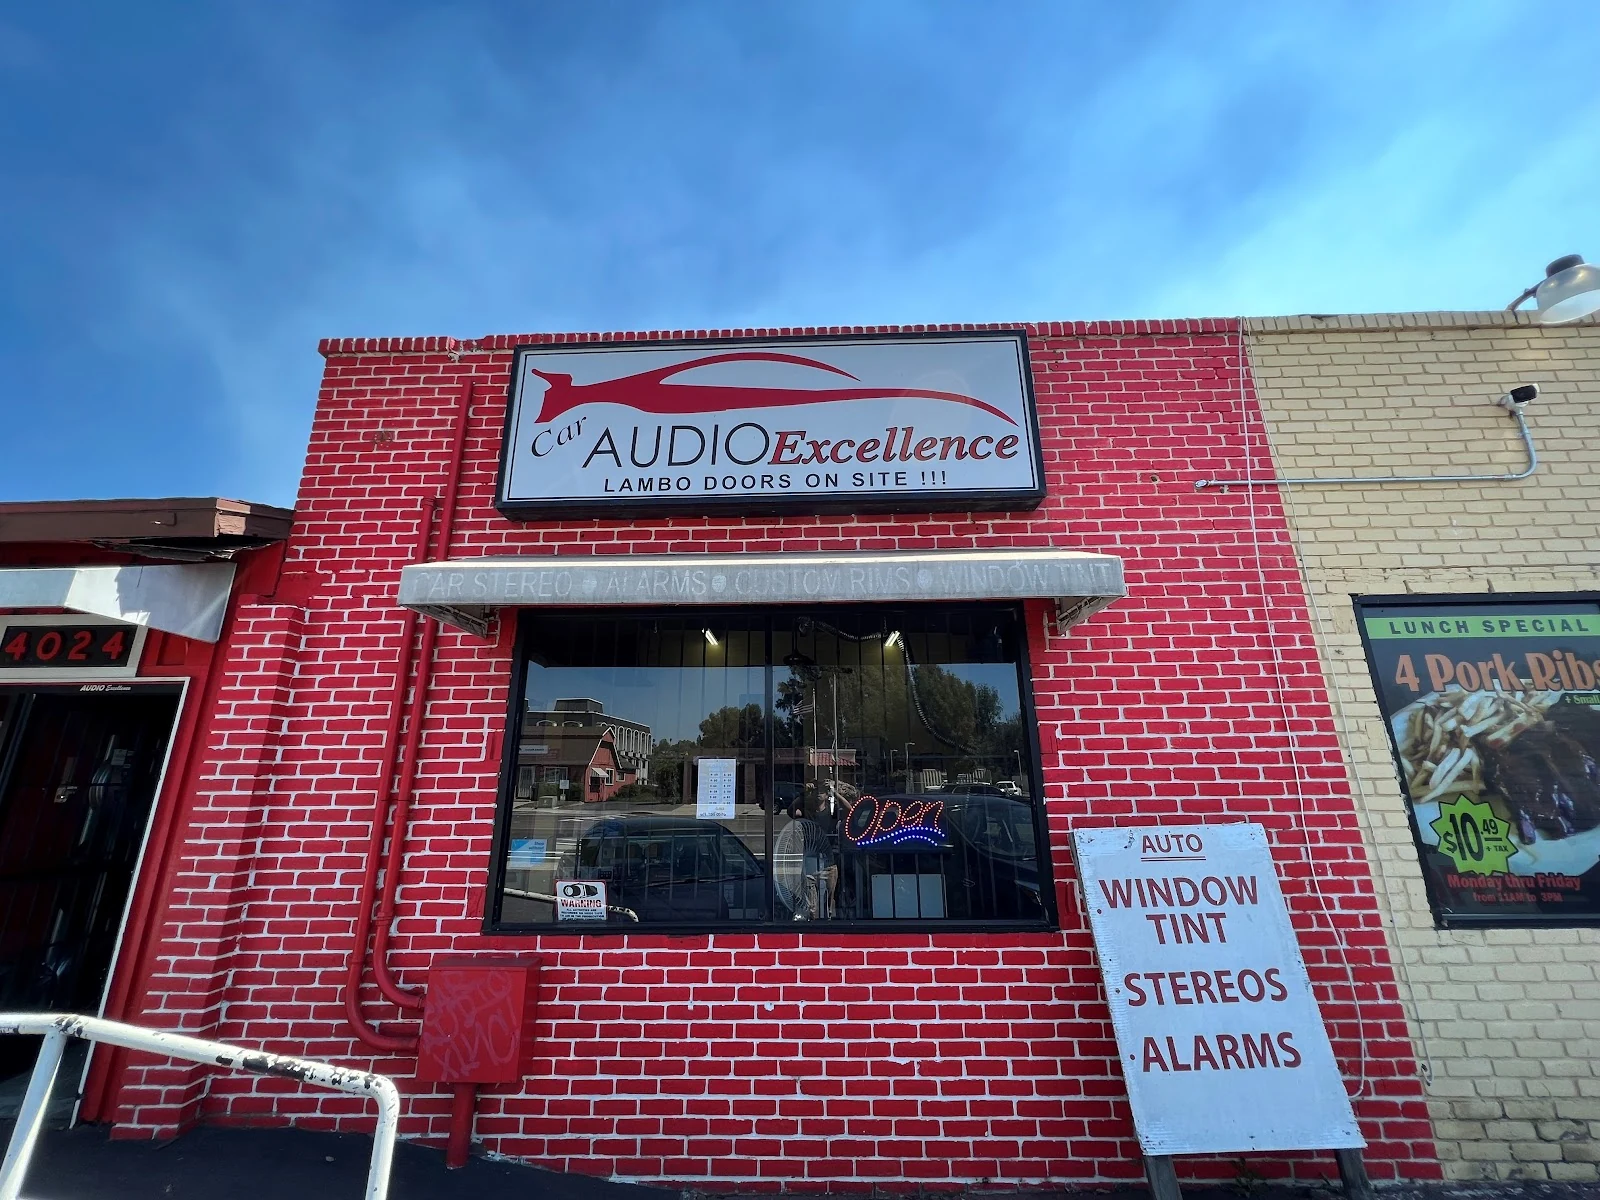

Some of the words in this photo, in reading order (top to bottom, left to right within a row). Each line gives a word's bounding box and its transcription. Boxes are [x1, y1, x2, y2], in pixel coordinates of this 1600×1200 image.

[530, 416, 587, 458] Car
[582, 422, 770, 469] AUDIO
[767, 426, 1020, 465] Excellence
[604, 477, 691, 493] LAMBO
[704, 474, 791, 491] DOORS
[805, 473, 838, 488] ON
[852, 472, 908, 487] SITE
[921, 471, 947, 486] !!!
[414, 572, 465, 598] CAR
[473, 571, 573, 597] STEREO
[606, 569, 707, 596] ALARMS
[735, 568, 842, 595] CUSTOM
[850, 566, 911, 595] RIMS
[938, 562, 1050, 593] WINDOW
[1388, 620, 1470, 635] LUNCH
[1482, 618, 1589, 634] SPECIAL
[5, 631, 124, 661] 4024
[1395, 654, 1420, 692] 4
[1424, 653, 1524, 692] Pork
[844, 796, 944, 842] Open
[1142, 833, 1203, 854] AUTO
[1099, 875, 1258, 909] WINDOW
[1447, 873, 1502, 890] Monday
[1504, 873, 1535, 888] thru
[1536, 873, 1580, 891] Friday
[1472, 892, 1496, 902] from
[560, 899, 602, 908] WARNING
[1146, 912, 1227, 945] TINT
[1123, 968, 1288, 1007] STEREOS
[1142, 1032, 1302, 1073] ALARMS
